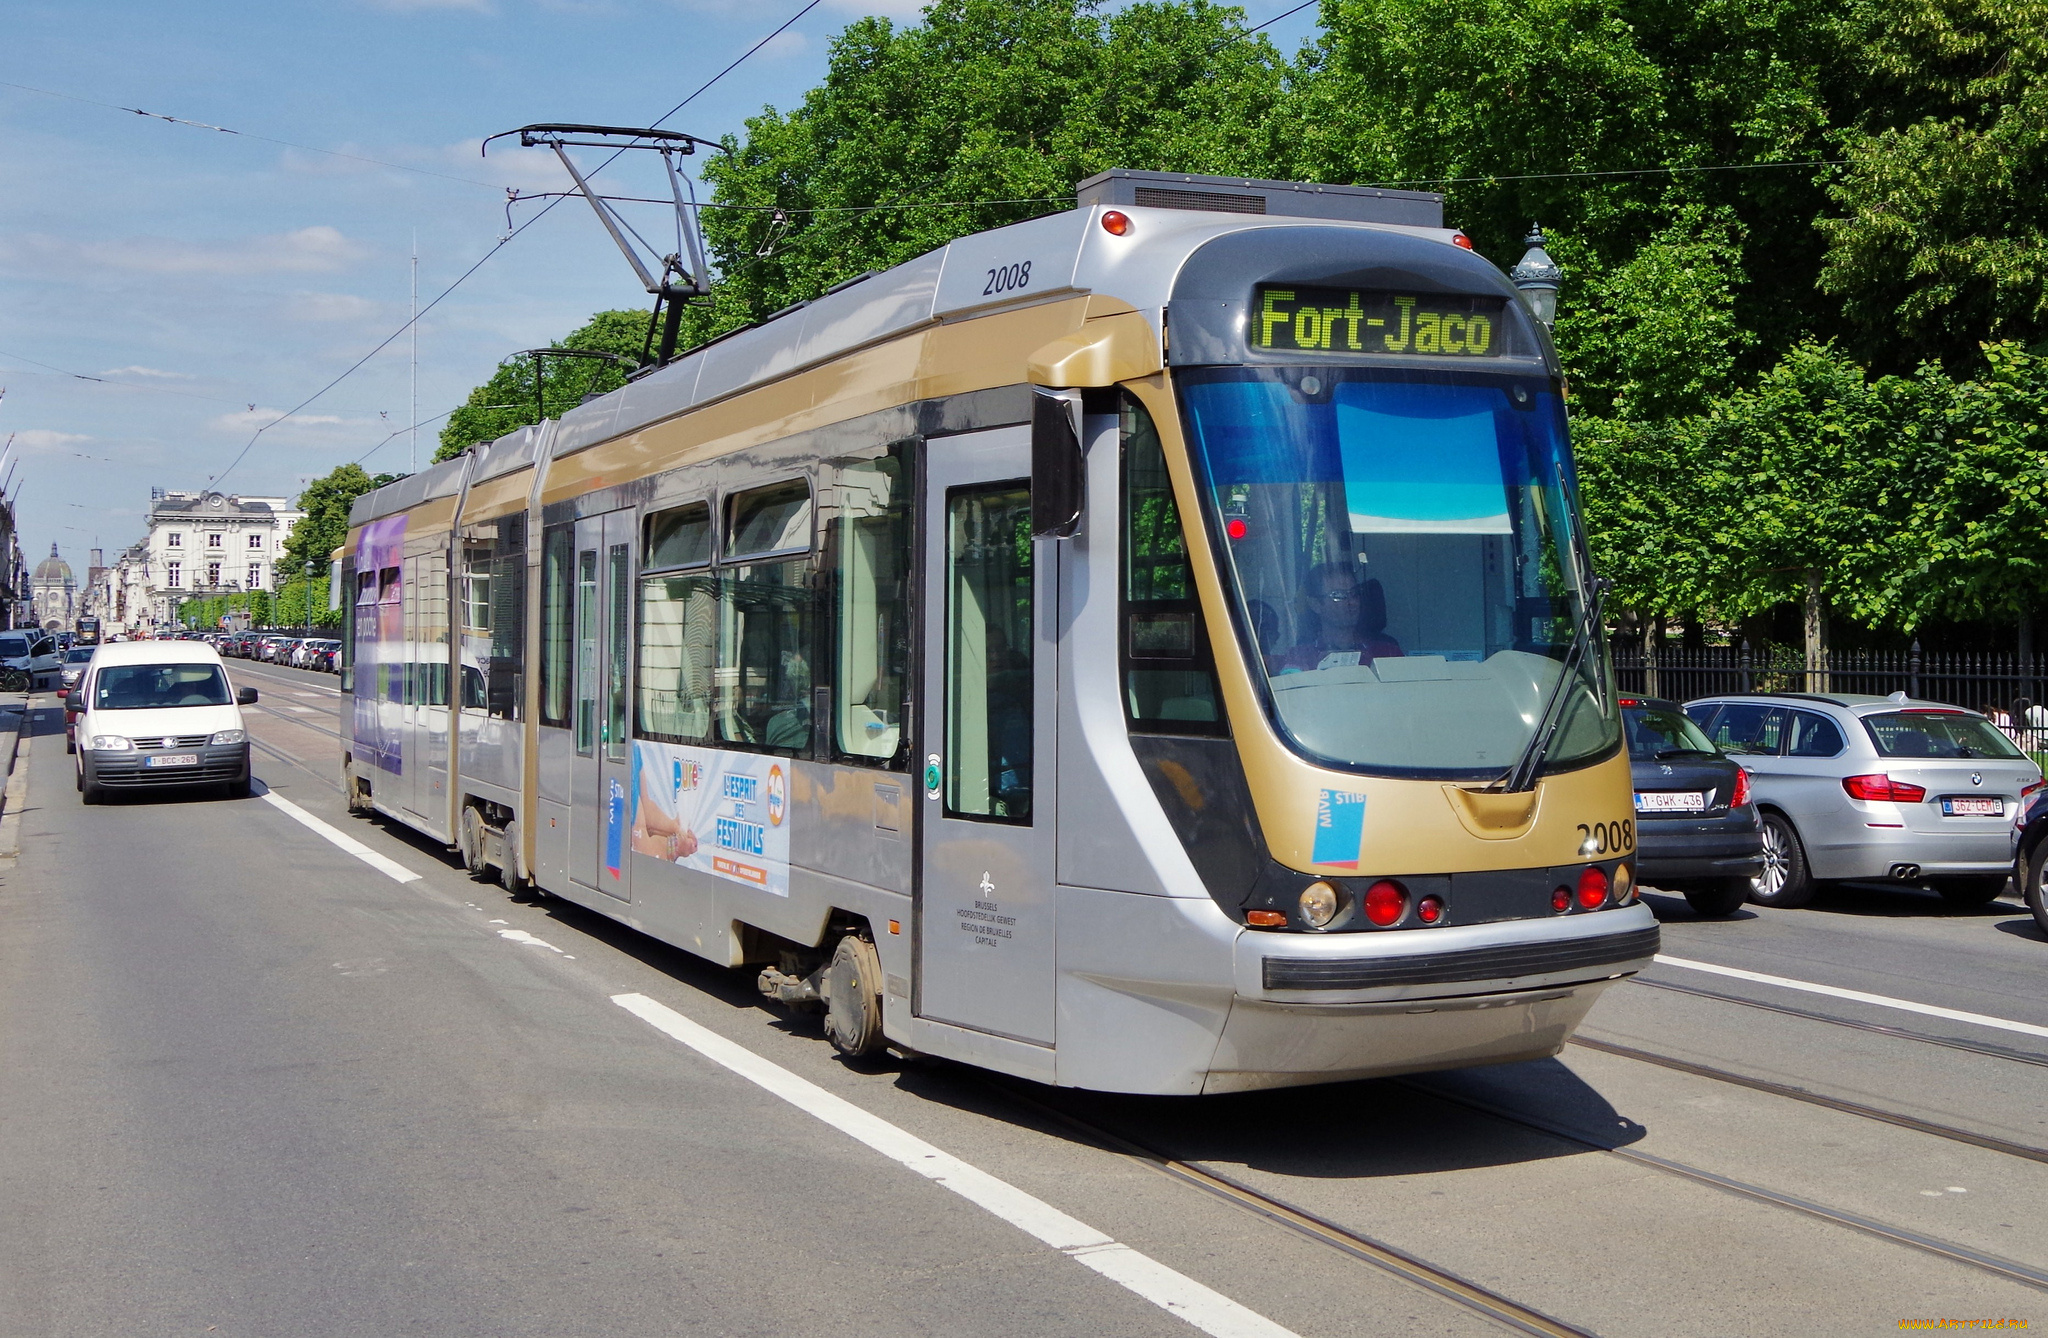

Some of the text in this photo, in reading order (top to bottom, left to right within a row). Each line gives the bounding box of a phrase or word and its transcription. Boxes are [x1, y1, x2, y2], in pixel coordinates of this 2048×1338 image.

[983, 260, 1032, 296] 2008
[1261, 290, 1491, 355] Fort-Jaco
[672, 756, 699, 803] pure
[723, 773, 757, 803] L'ESPRIT
[1319, 790, 1332, 827] MIVB
[1335, 792, 1365, 805] STIB
[1643, 794, 1702, 807] 1-GWK-436
[716, 817, 764, 856] FESTIVALS
[1577, 818, 1633, 856] 2008
[956, 909, 1017, 926] HOOFDSTEDELIJK GEWEST
[975, 900, 998, 912] BRUSSELS
[975, 935, 997, 947] CAPITALE
[979, 925, 986, 934] DE
[986, 926, 1012, 939] BRUXELLES
